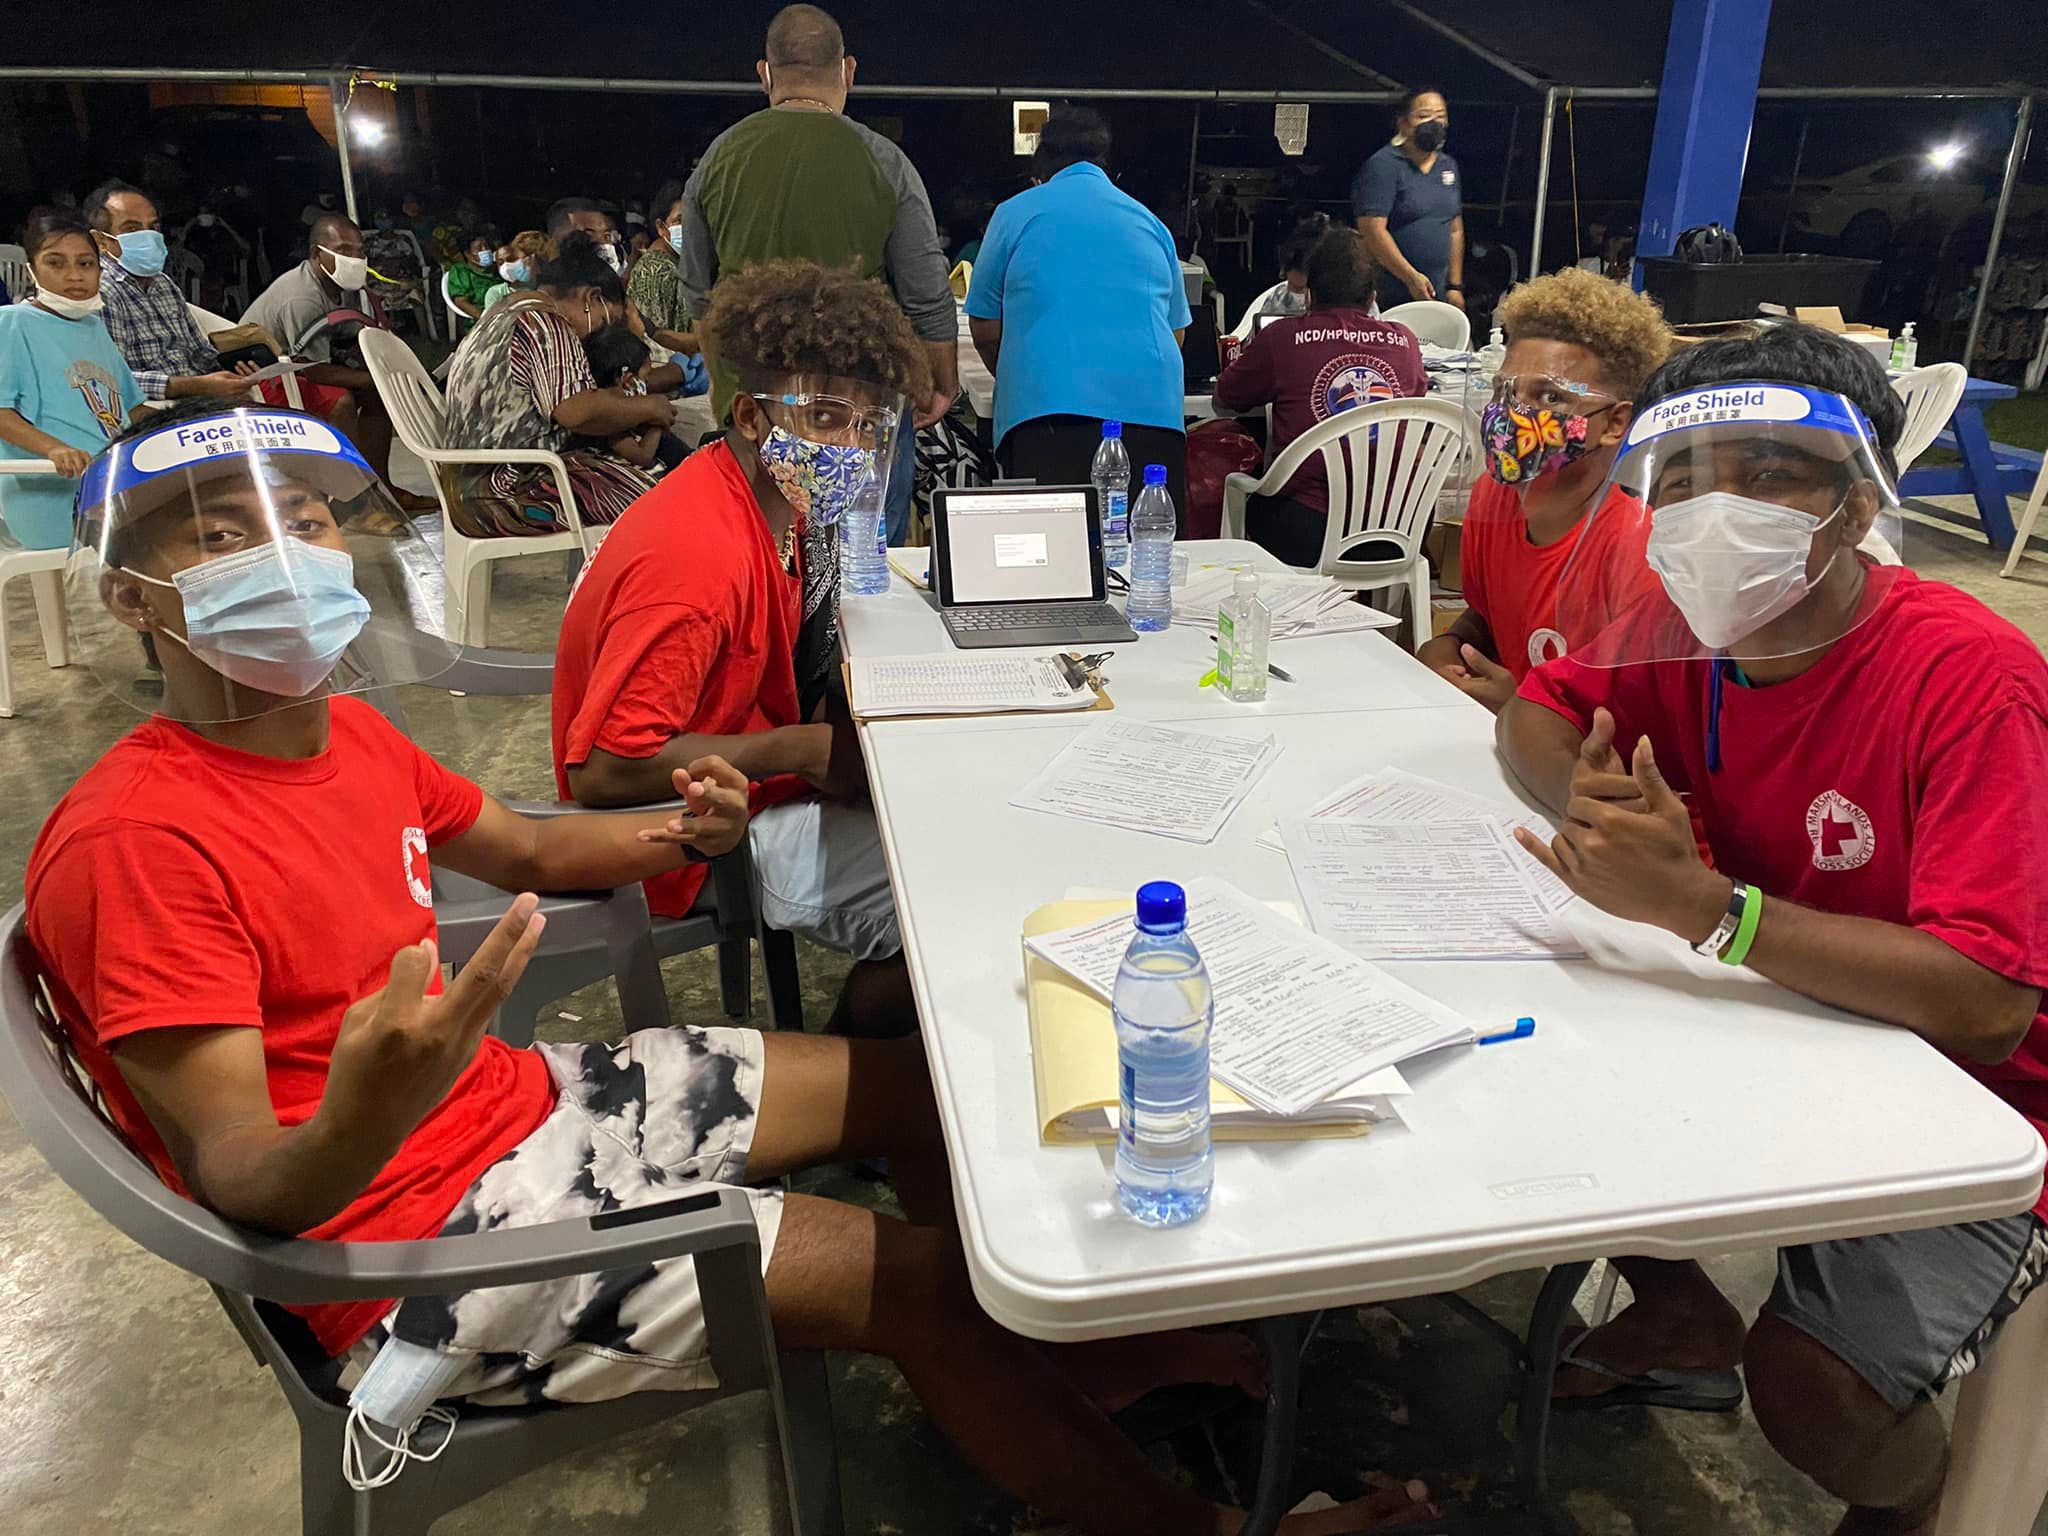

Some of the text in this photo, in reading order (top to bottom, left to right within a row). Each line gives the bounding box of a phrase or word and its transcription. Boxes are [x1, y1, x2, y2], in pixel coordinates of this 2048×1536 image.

[1652, 390, 1765, 423] Face Shield
[176, 424, 233, 448] Face
